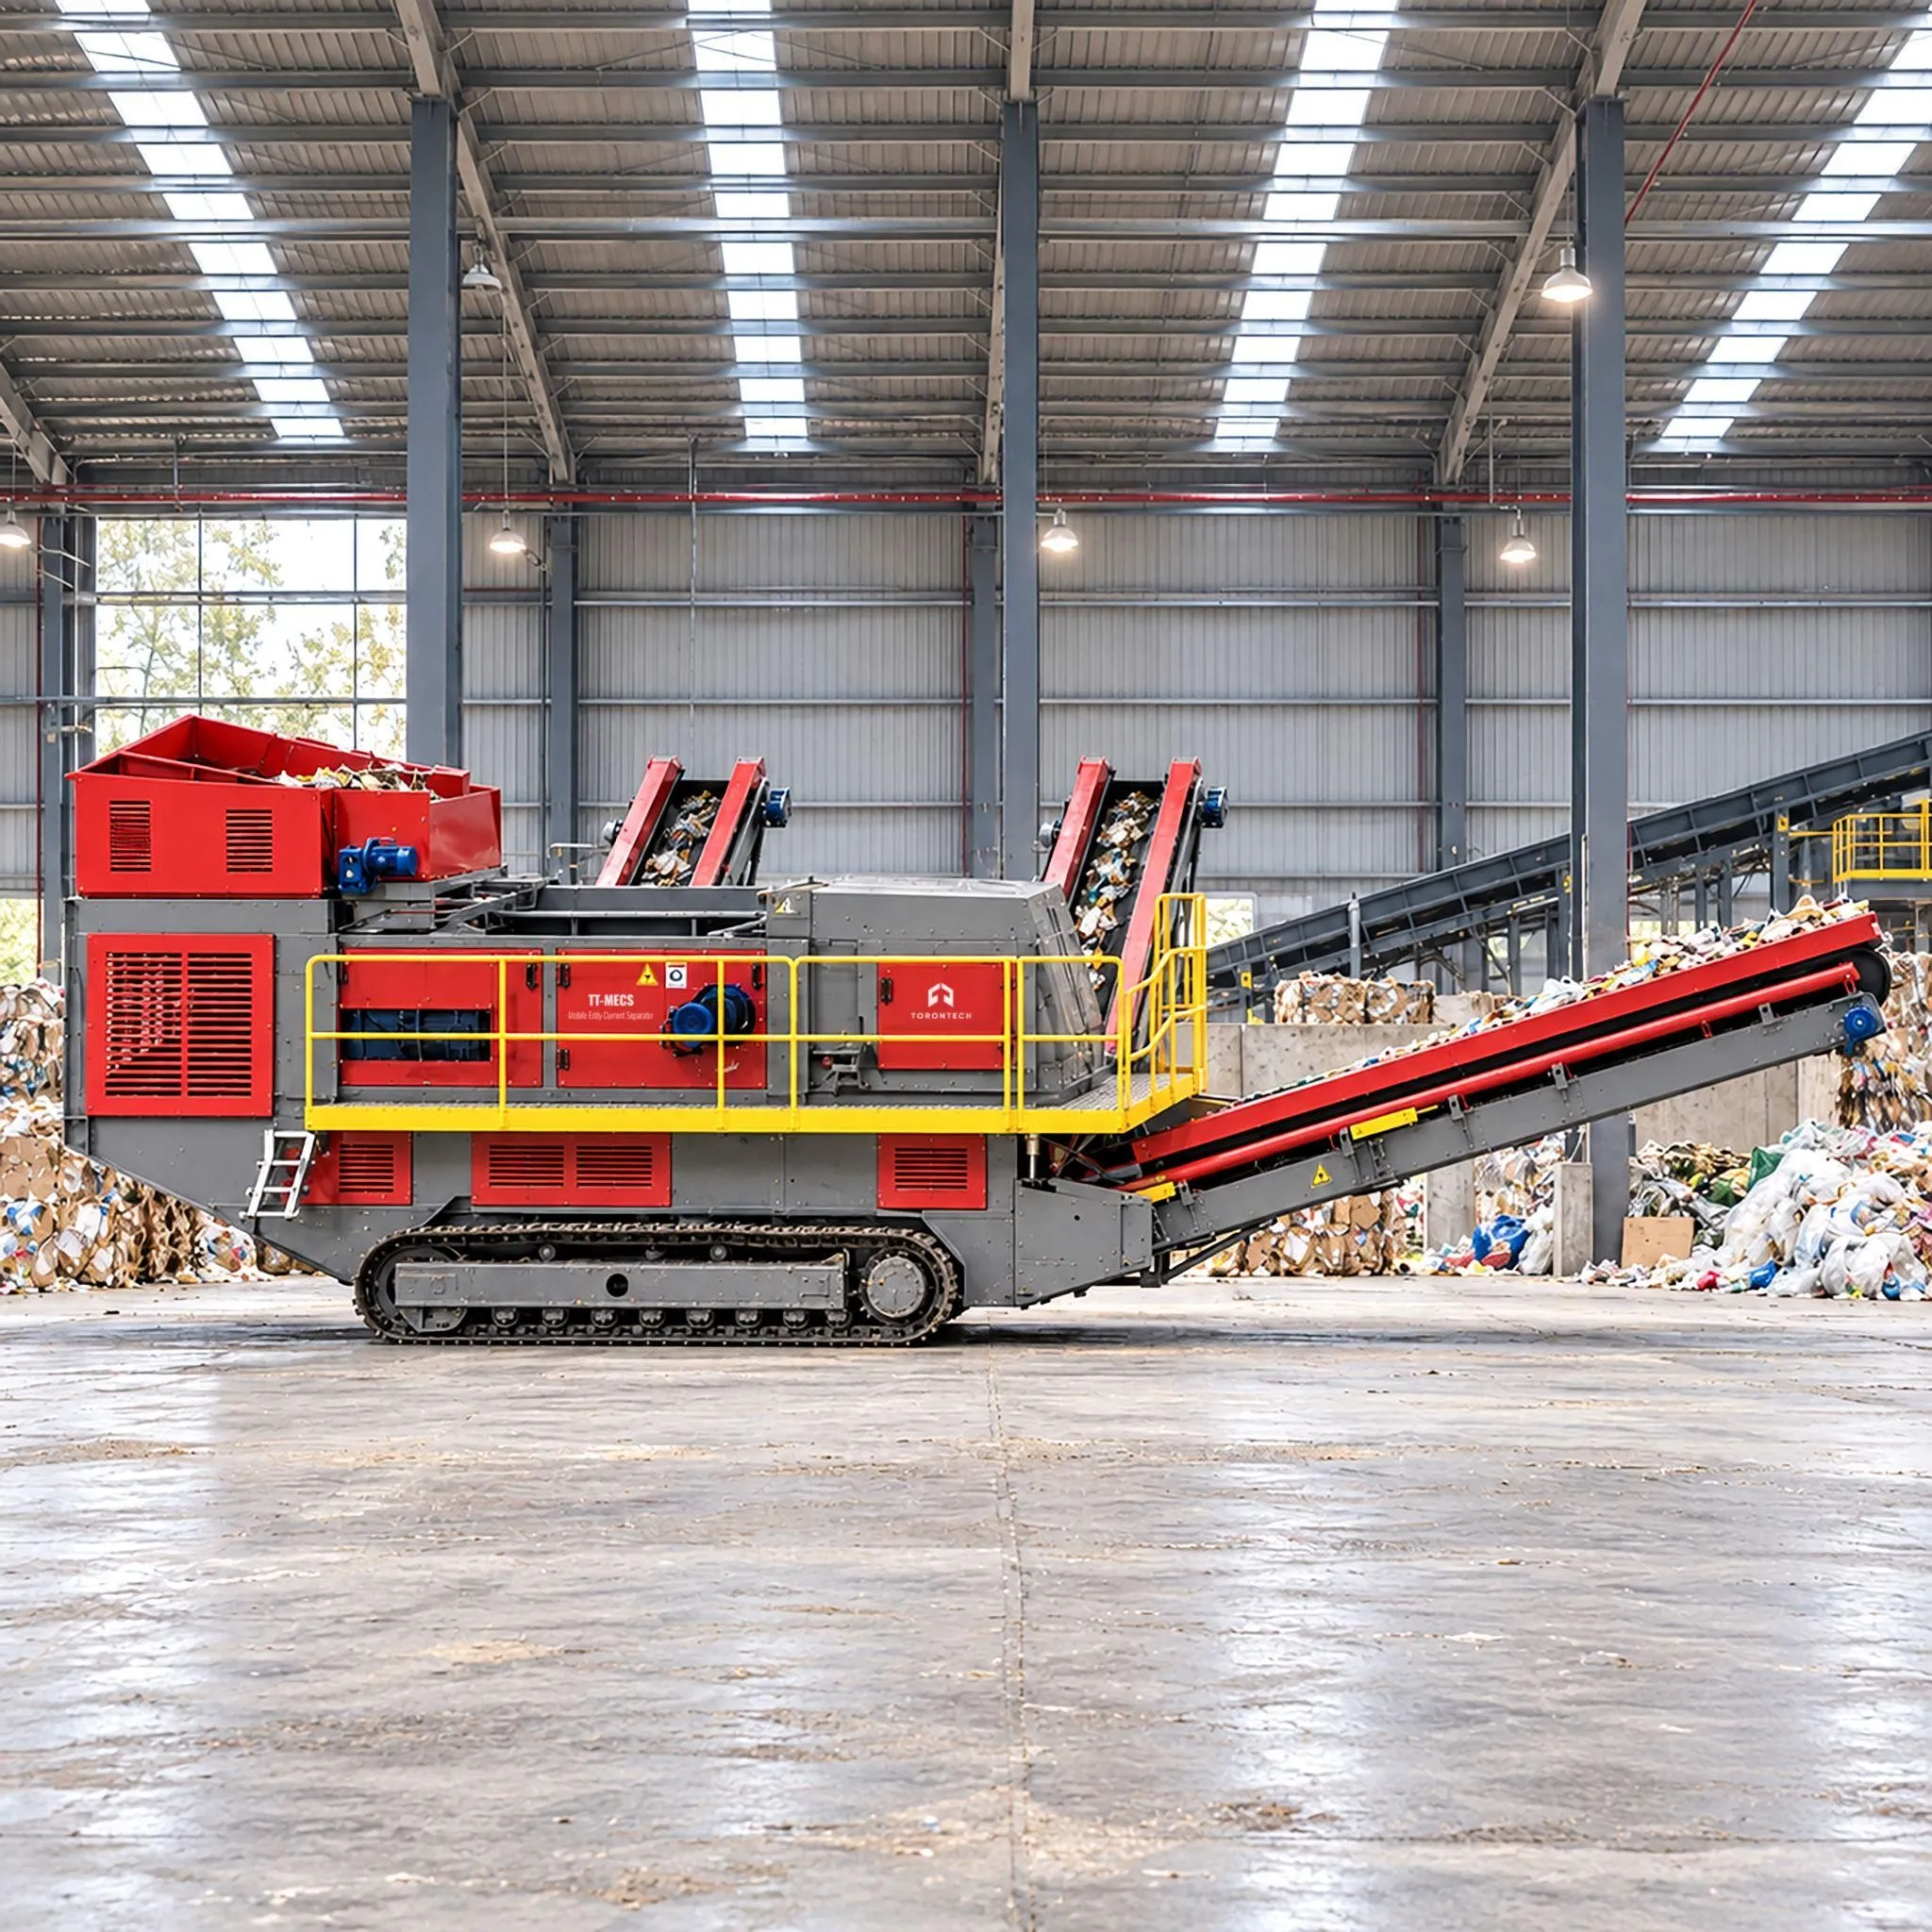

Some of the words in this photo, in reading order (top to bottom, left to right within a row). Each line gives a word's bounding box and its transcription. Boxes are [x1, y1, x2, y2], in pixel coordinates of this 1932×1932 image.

[588, 993, 634, 1007] TT-MECS
[568, 1011, 587, 1020] Mobile
[603, 1011, 625, 1020] Current
[626, 1011, 654, 1021] Separator
